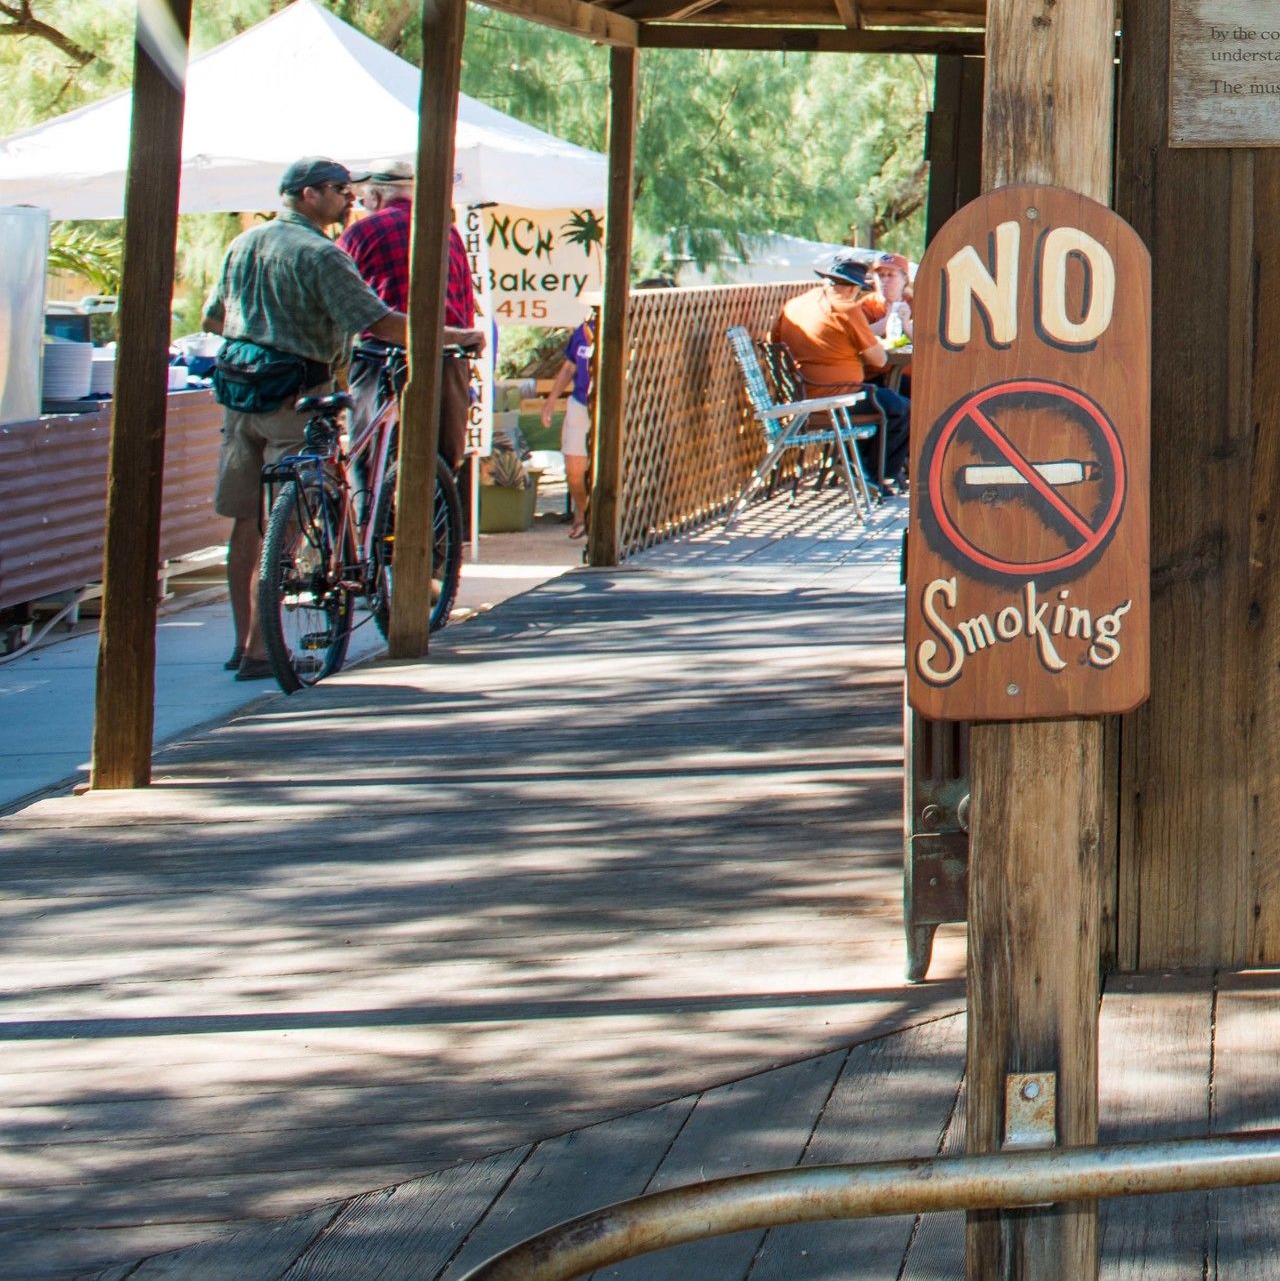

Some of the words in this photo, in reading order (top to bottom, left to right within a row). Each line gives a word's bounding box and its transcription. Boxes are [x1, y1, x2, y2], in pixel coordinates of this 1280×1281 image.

[1211, 27, 1230, 43] by
[1233, 27, 1257, 40] the
[1210, 79, 1244, 94] The
[496, 299, 548, 319] 415
[943, 220, 1116, 349] NO
[467, 352, 483, 448] ANCH
[917, 576, 1132, 684] Smoking
